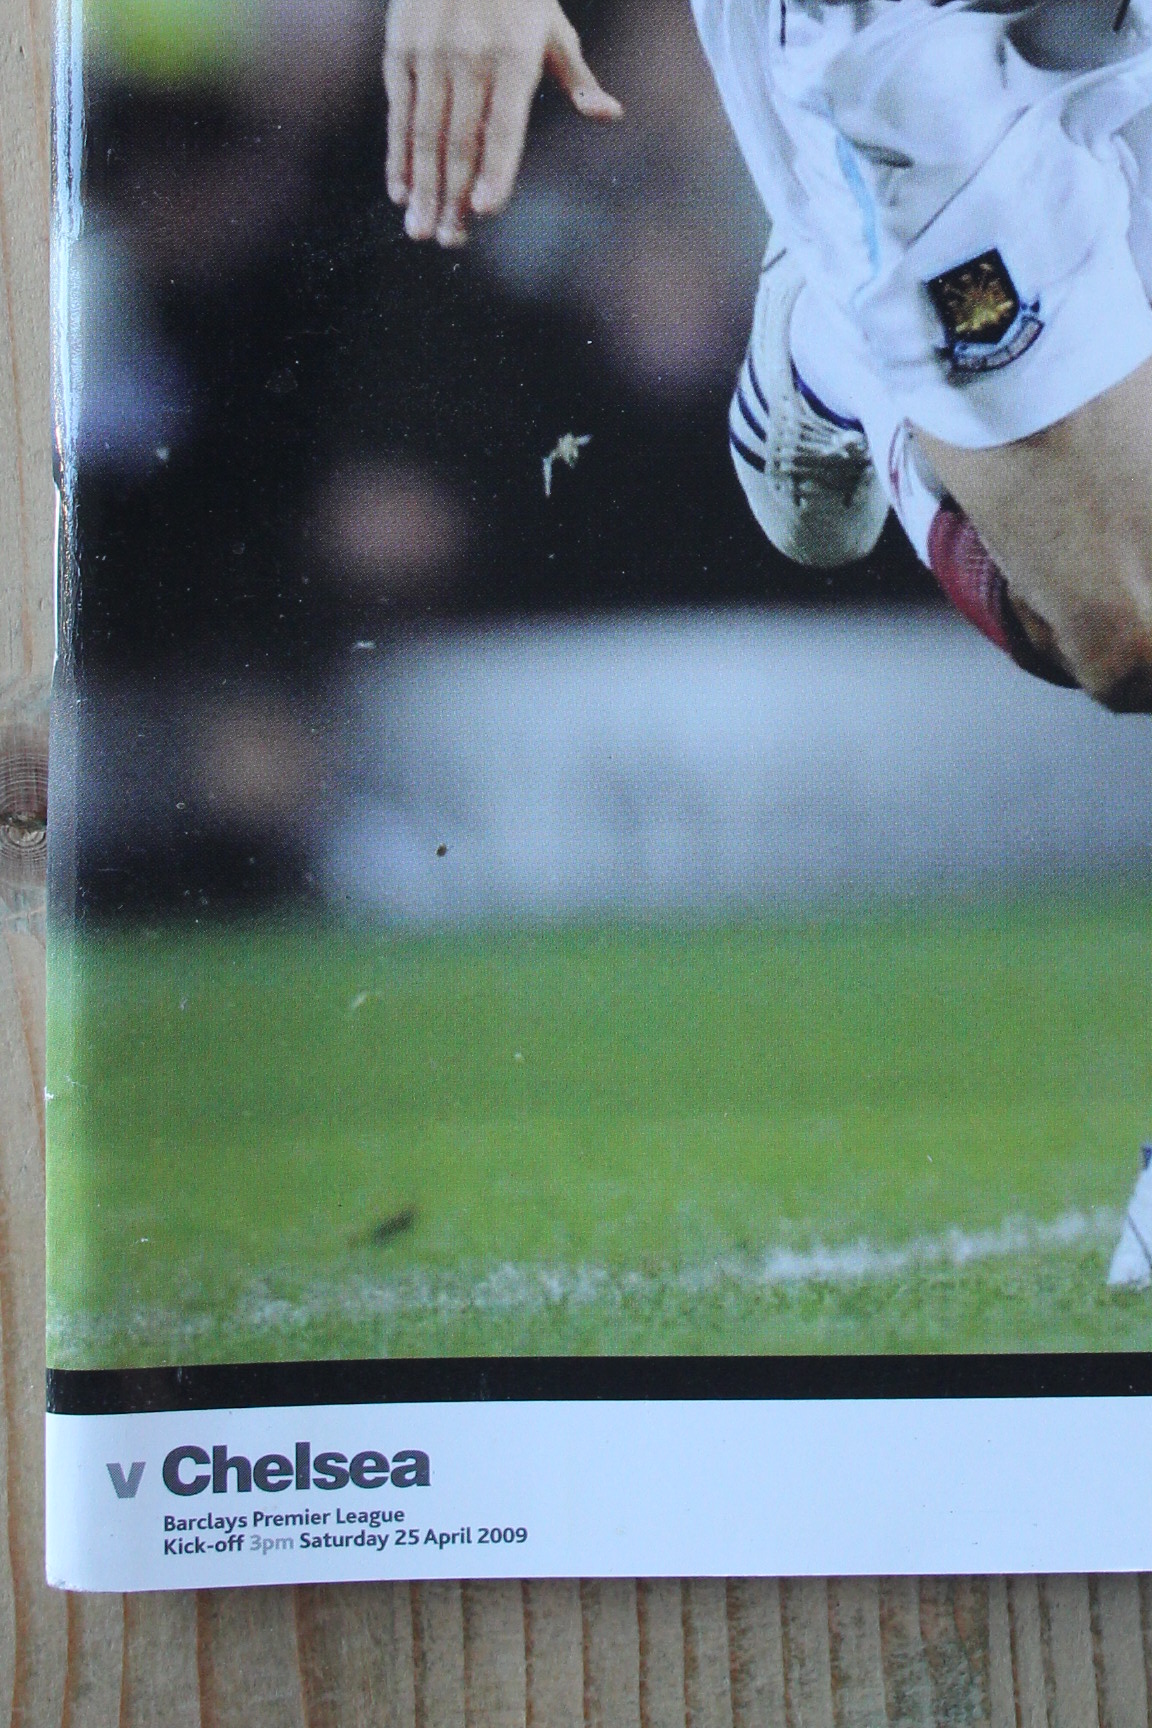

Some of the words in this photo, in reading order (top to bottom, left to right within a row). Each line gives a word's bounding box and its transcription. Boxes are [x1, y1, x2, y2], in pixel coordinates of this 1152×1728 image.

[106, 1461, 146, 1499] v
[162, 1441, 431, 1497] Chelsea
[163, 1513, 248, 1534] Barclays
[253, 1510, 331, 1529] Premier
[336, 1507, 406, 1532] League
[163, 1530, 245, 1556] Kick-off
[249, 1534, 294, 1556] 3pm
[299, 1525, 389, 1552] Saturday
[394, 1529, 420, 1546] 25
[423, 1526, 473, 1550] April
[477, 1527, 528, 1544] 2009
